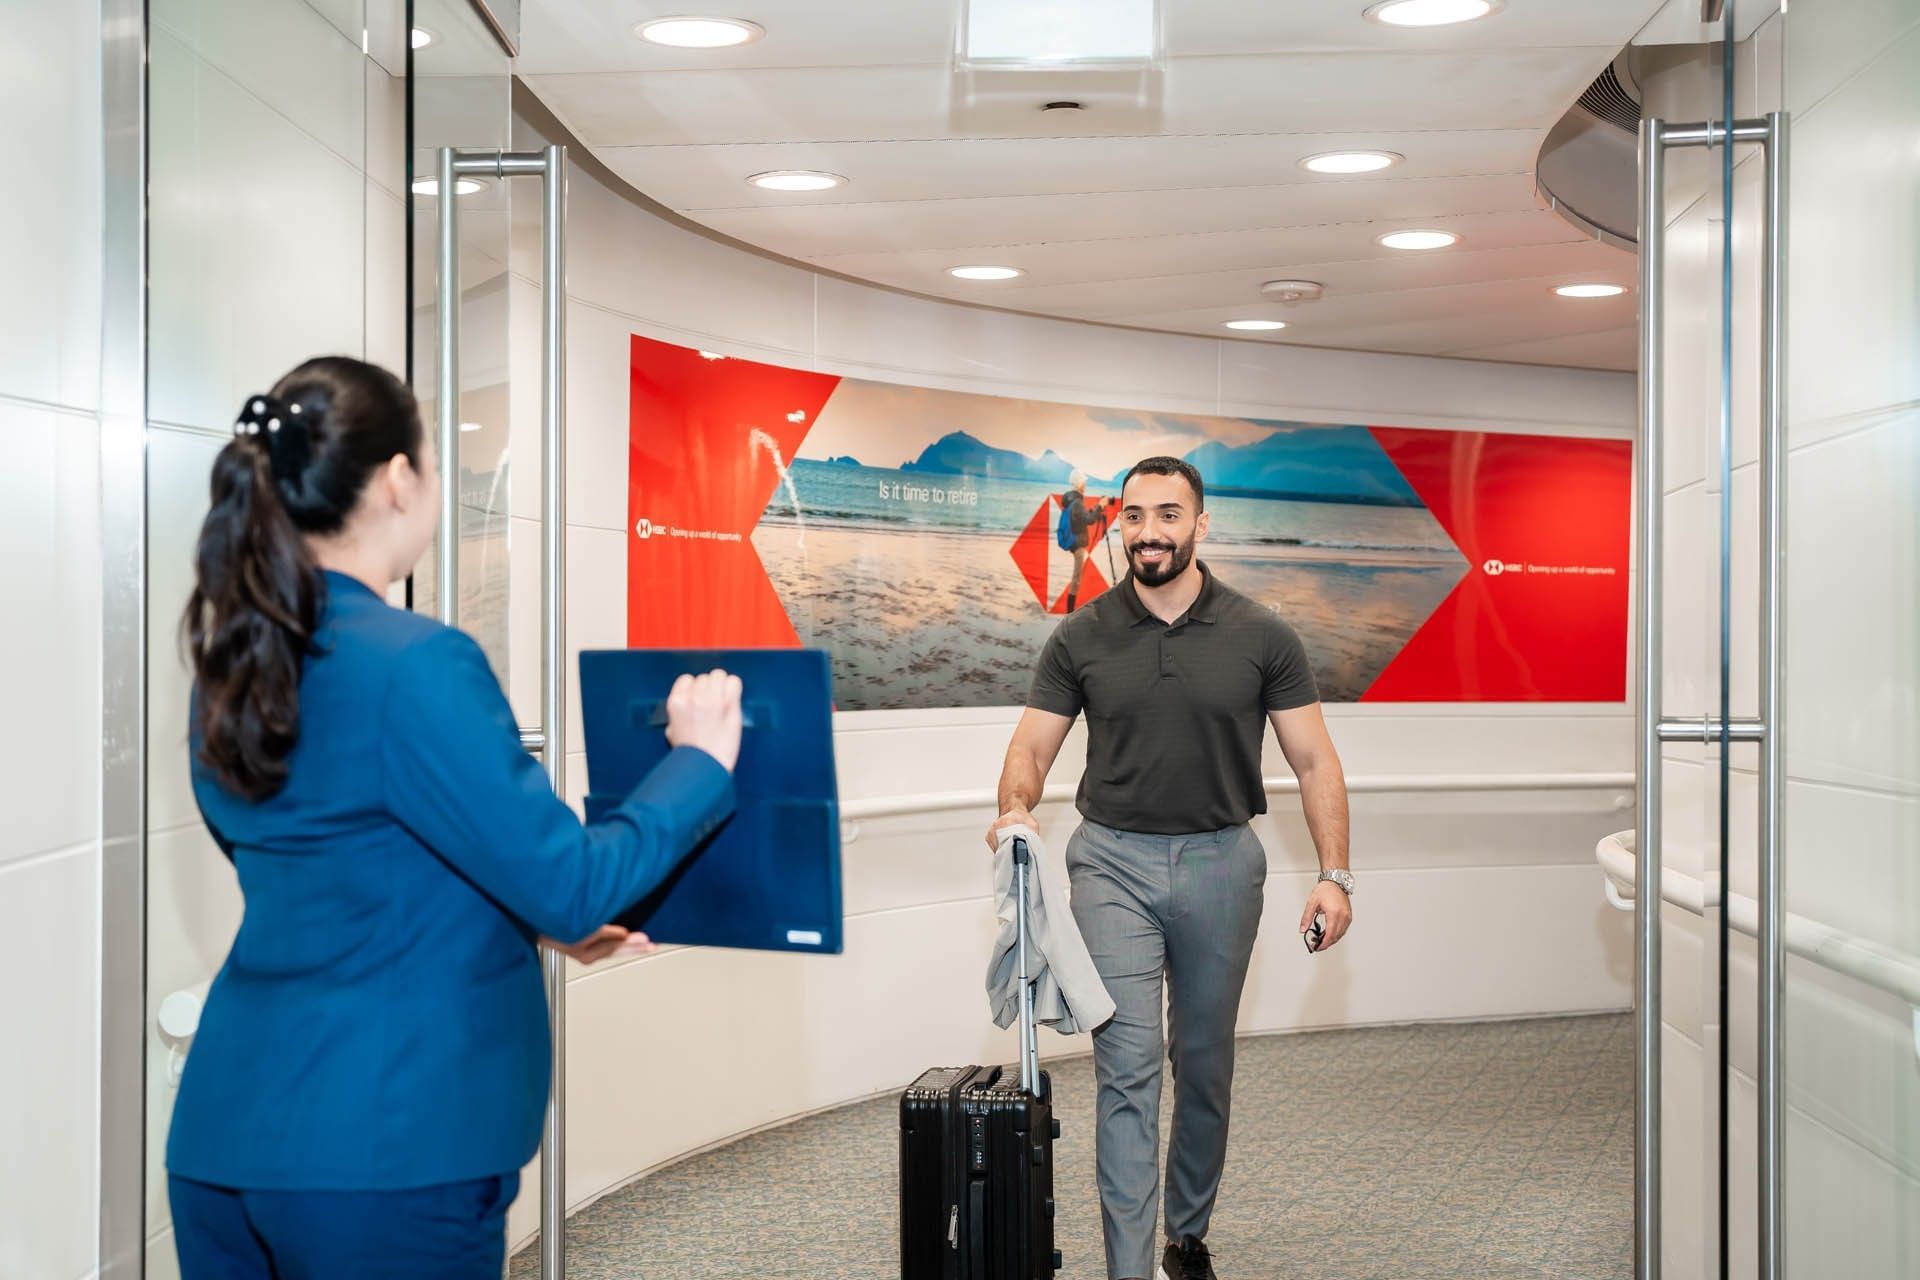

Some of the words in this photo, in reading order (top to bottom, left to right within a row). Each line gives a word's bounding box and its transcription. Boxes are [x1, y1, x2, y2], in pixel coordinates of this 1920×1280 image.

[879, 480, 889, 499] Is
[892, 481, 900, 500] it
[903, 482, 929, 502] time
[932, 488, 945, 504] to
[947, 487, 978, 505] retire
